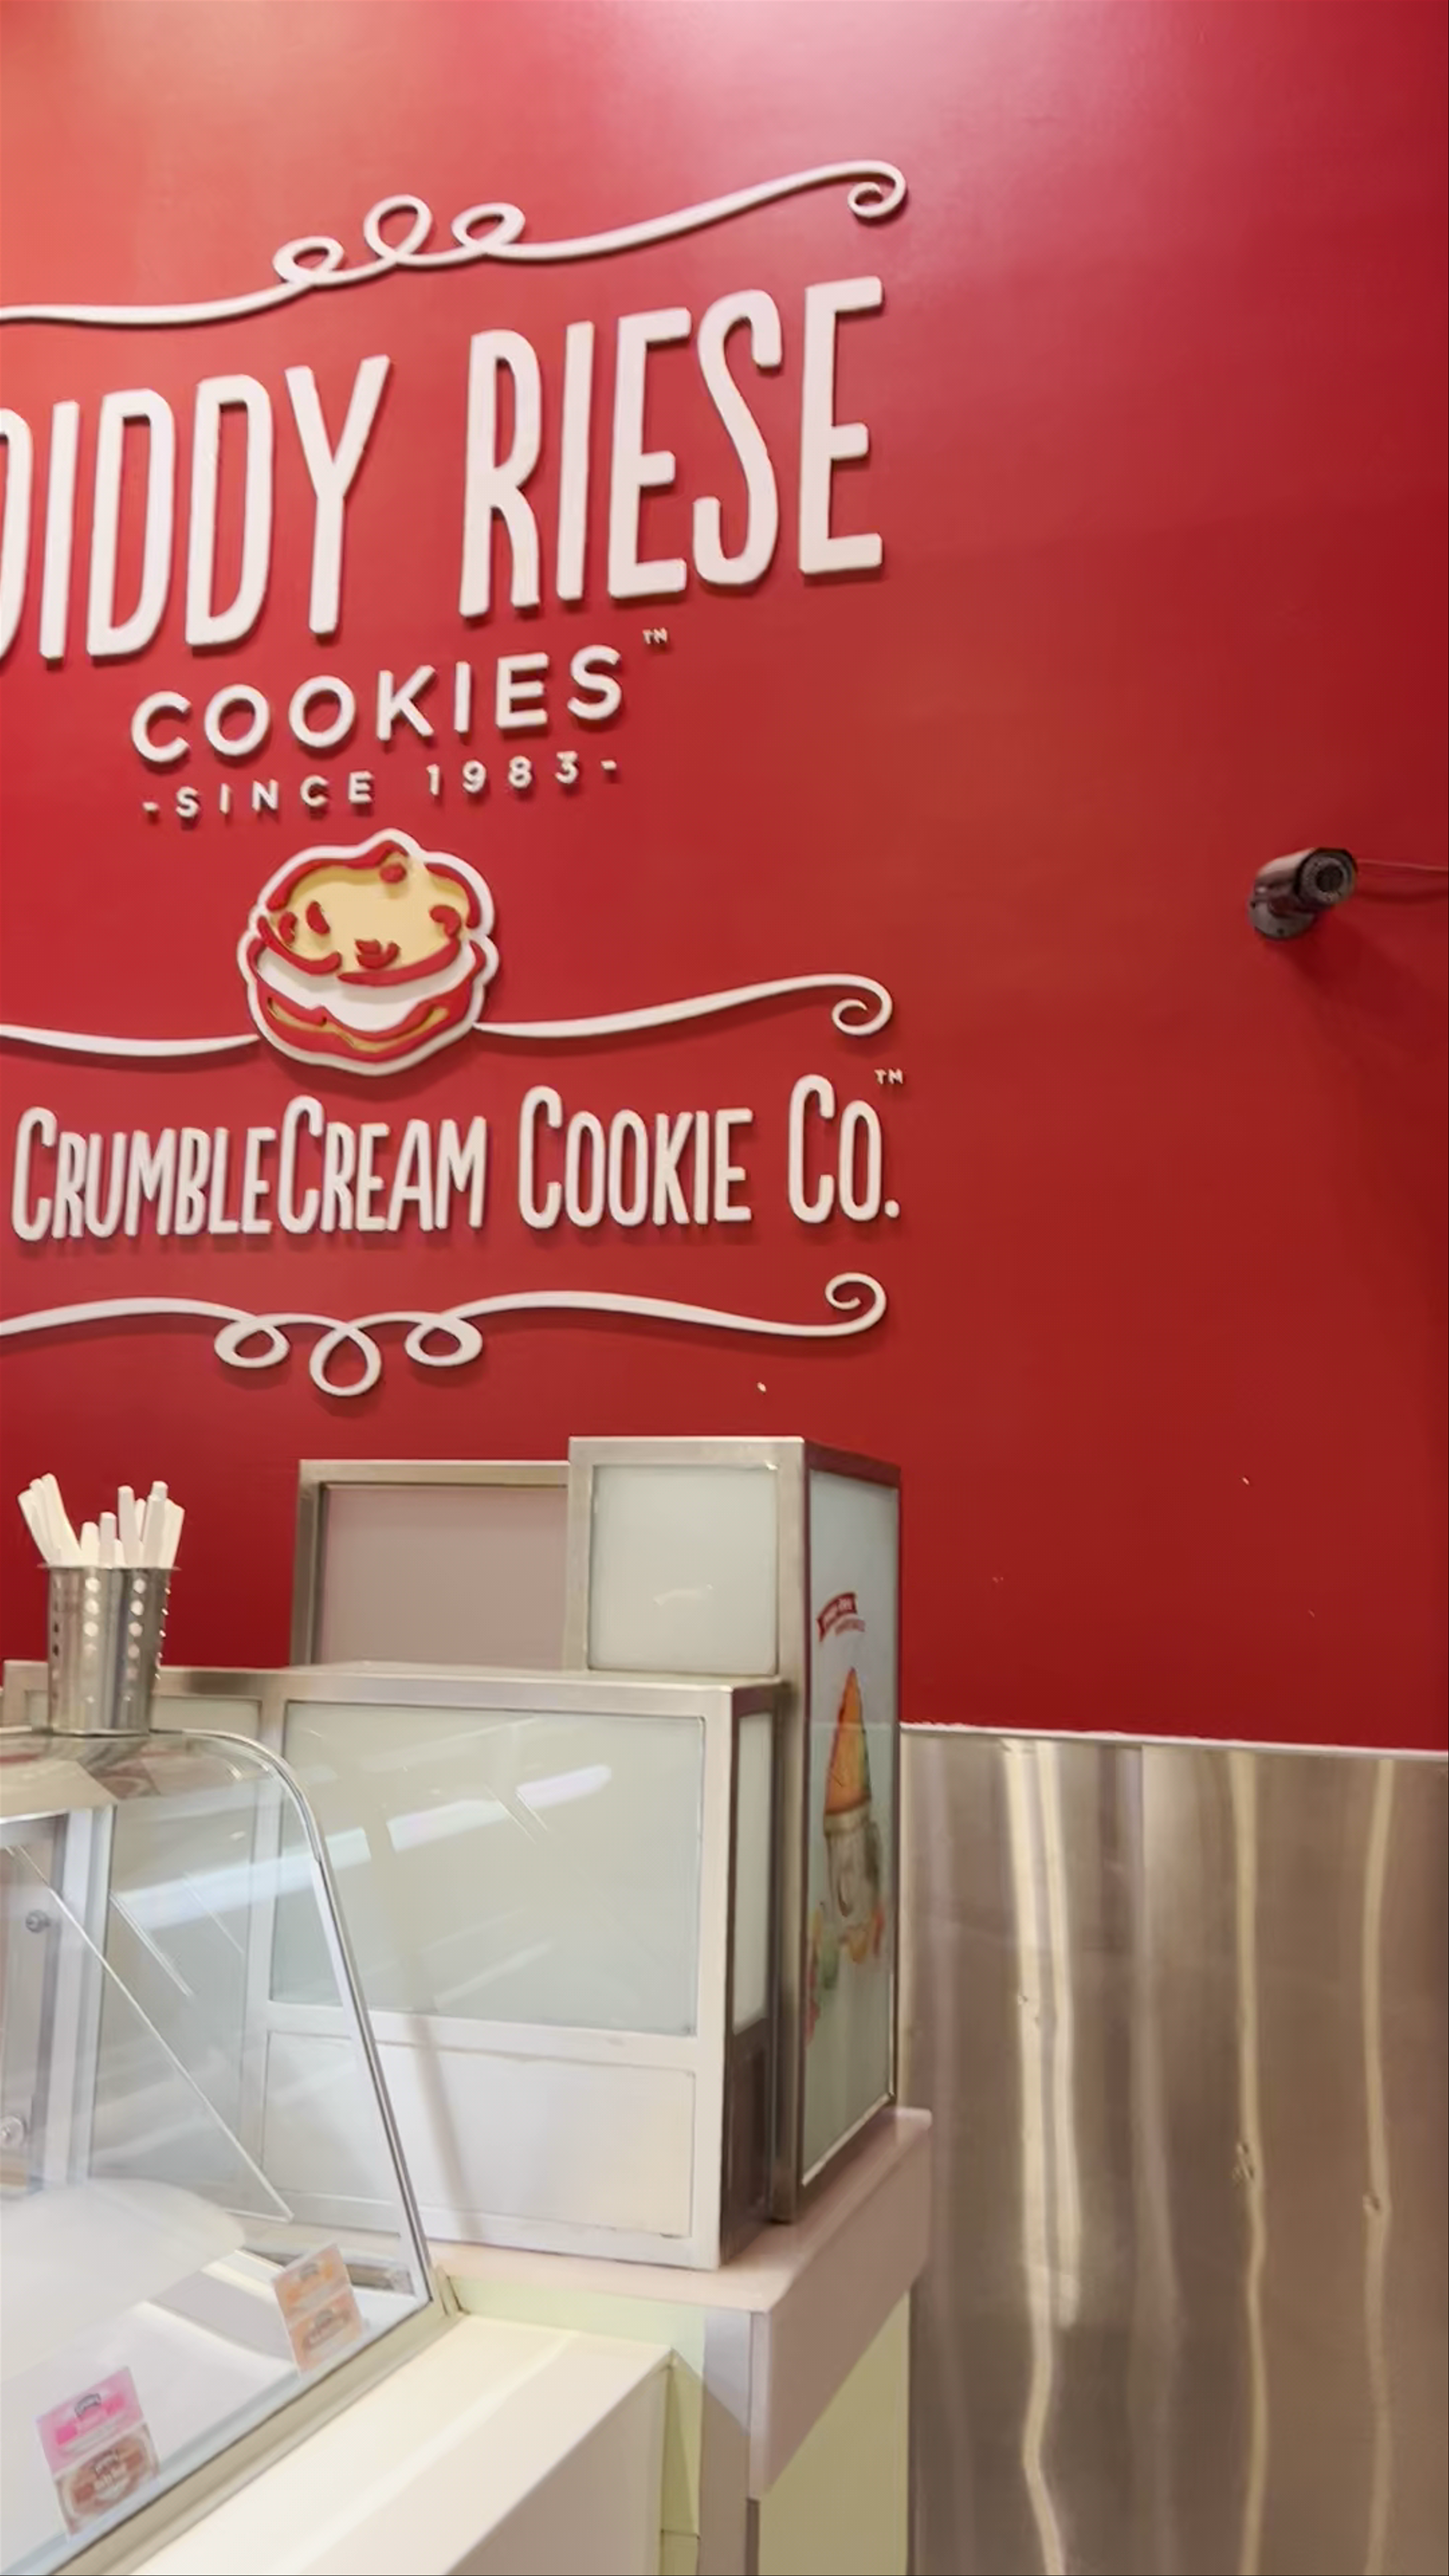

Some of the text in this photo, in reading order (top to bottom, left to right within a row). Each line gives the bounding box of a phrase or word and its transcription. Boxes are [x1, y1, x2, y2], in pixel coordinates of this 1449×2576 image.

[459, 276, 883, 618] RIESE
[131, 645, 621, 763] COOKIES
[142, 751, 617, 819] -SINCE 1983-
[518, 1085, 753, 1229] COOKIE
[788, 1074, 900, 1224] CO.
